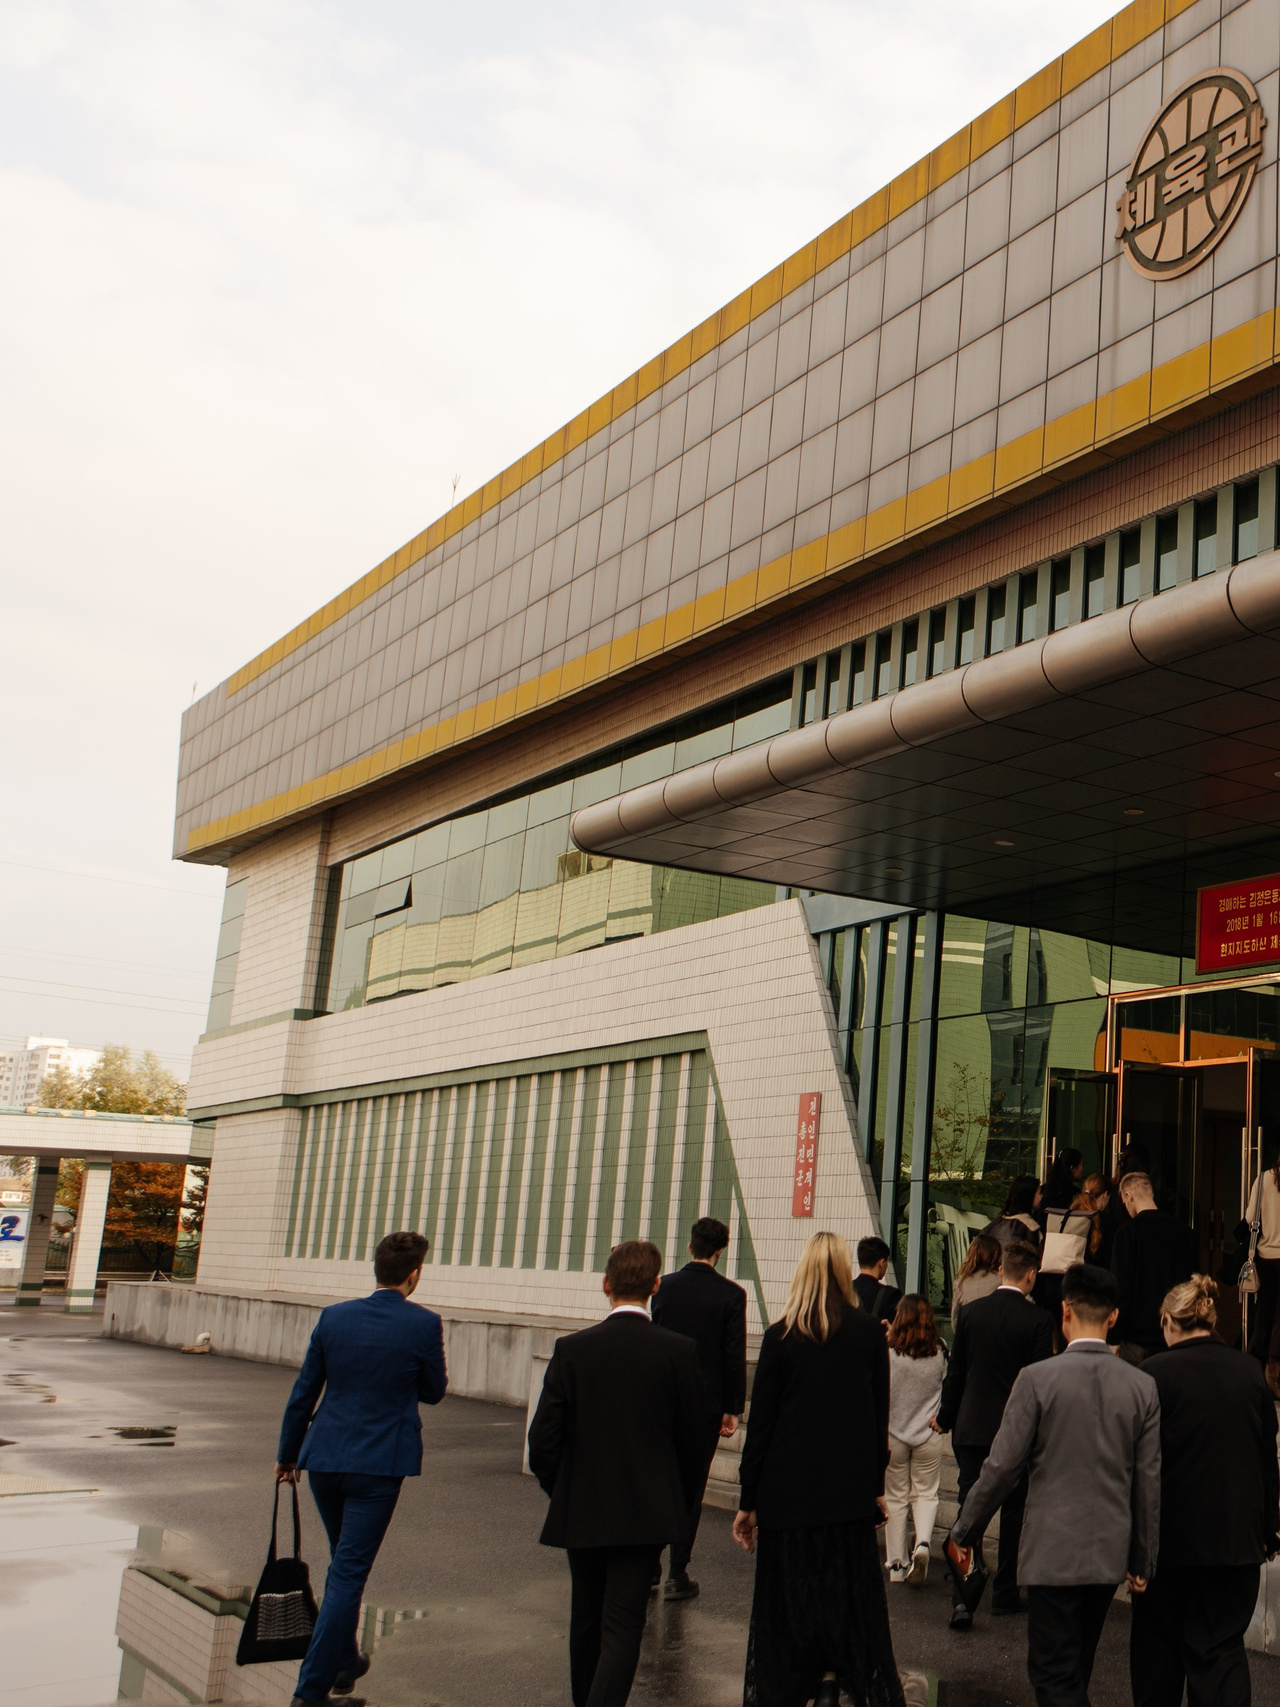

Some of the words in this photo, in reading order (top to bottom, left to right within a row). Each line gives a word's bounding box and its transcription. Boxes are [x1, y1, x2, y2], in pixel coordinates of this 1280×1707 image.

[1115, 104, 1267, 239] 체육관
[1218, 896, 1246, 912] 경애하는
[1226, 915, 1249, 933] 2018년
[1252, 913, 1263, 927] 1월
[1220, 936, 1267, 957] 현지지도하신
